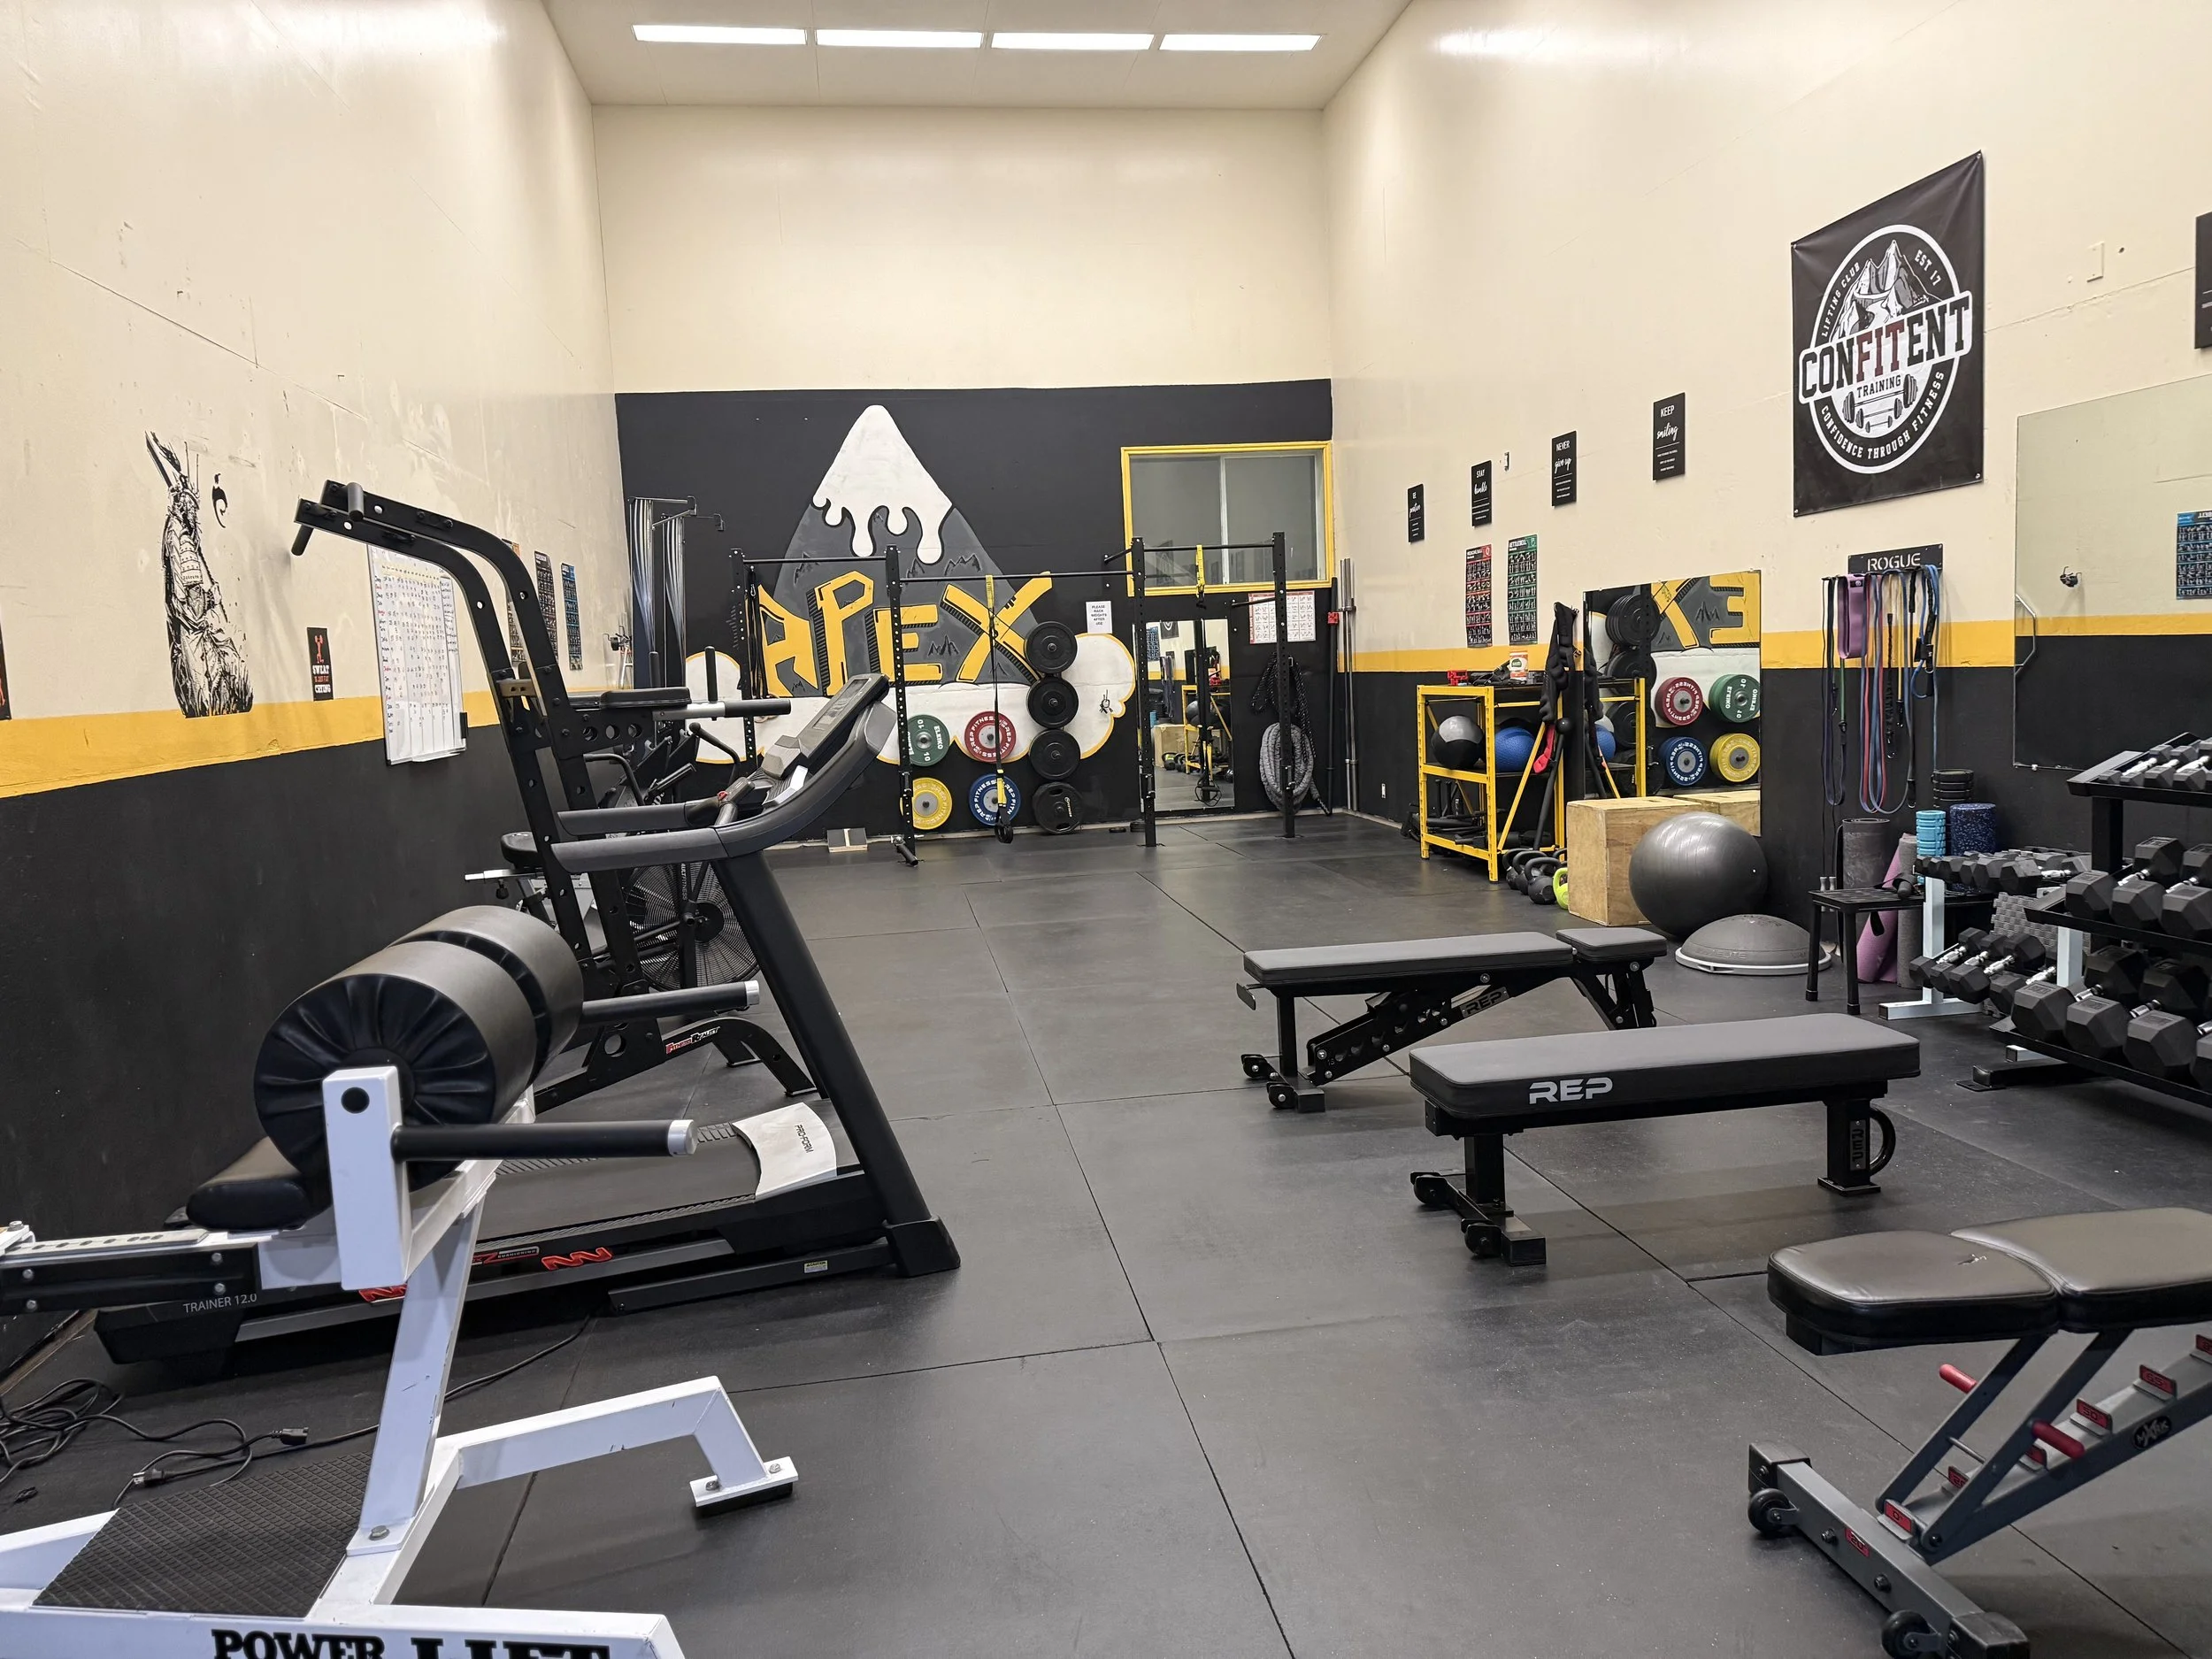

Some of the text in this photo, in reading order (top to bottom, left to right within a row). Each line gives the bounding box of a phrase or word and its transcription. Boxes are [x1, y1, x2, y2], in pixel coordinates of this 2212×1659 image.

[1914, 250, 1942, 287] EST 17
[1821, 262, 1861, 338] LIFTING CLUB
[1801, 296, 1970, 399] CONFITENT
[1857, 375, 1901, 398] TRAINING
[1660, 404, 1675, 418] KEEP
[1822, 371, 1945, 460] CONFIDENCE THROUGH FITNESS
[1656, 422, 1678, 442] smiling
[1555, 440, 1571, 452] NEVER
[1564, 457, 1571, 471] up
[1867, 552, 1921, 572] ROGUE
[758, 571, 1053, 698] APEX
[312, 664, 330, 676] SWEAT
[314, 684, 331, 694] CRYING
[918, 719, 925, 729] 10
[971, 716, 995, 731] FITNES
[933, 725, 944, 750] ELEIKO
[924, 751, 931, 762] 10
[1465, 990, 1502, 1013] REP
[1529, 1077, 1613, 1105] REP
[795, 1124, 814, 1154] PRO-FORM
[1852, 1128, 1864, 1163] REP
[183, 1293, 257, 1314] TRAINER 12.0
[211, 1629, 385, 1659] POWER
